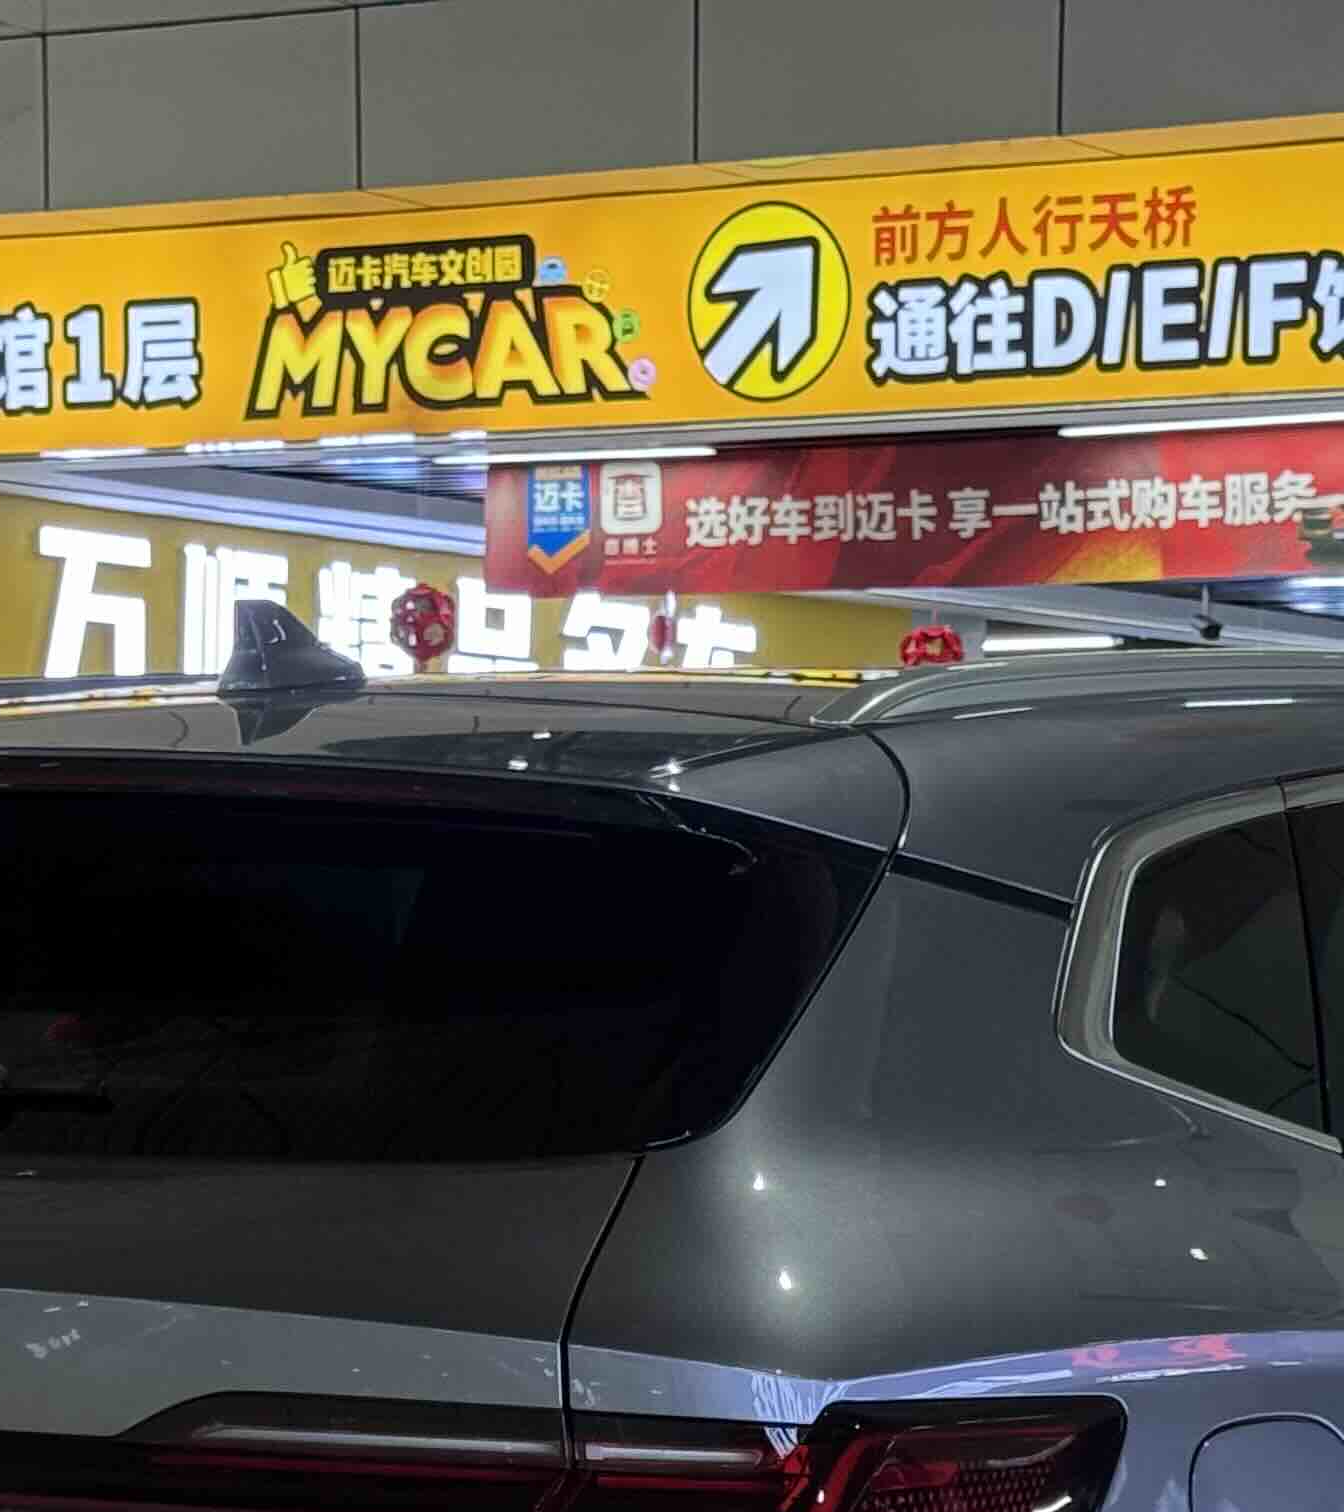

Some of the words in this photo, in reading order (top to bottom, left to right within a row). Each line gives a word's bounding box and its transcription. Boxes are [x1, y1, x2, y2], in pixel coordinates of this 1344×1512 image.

[871, 186, 1197, 265] 前方人行天桥
[327, 246, 523, 290] 迈卡汽车文创园
[252, 292, 634, 418] MYCAR
[686, 490, 936, 549] 选好车到迈卡
[949, 470, 1316, 538] 享一站式购车服务
